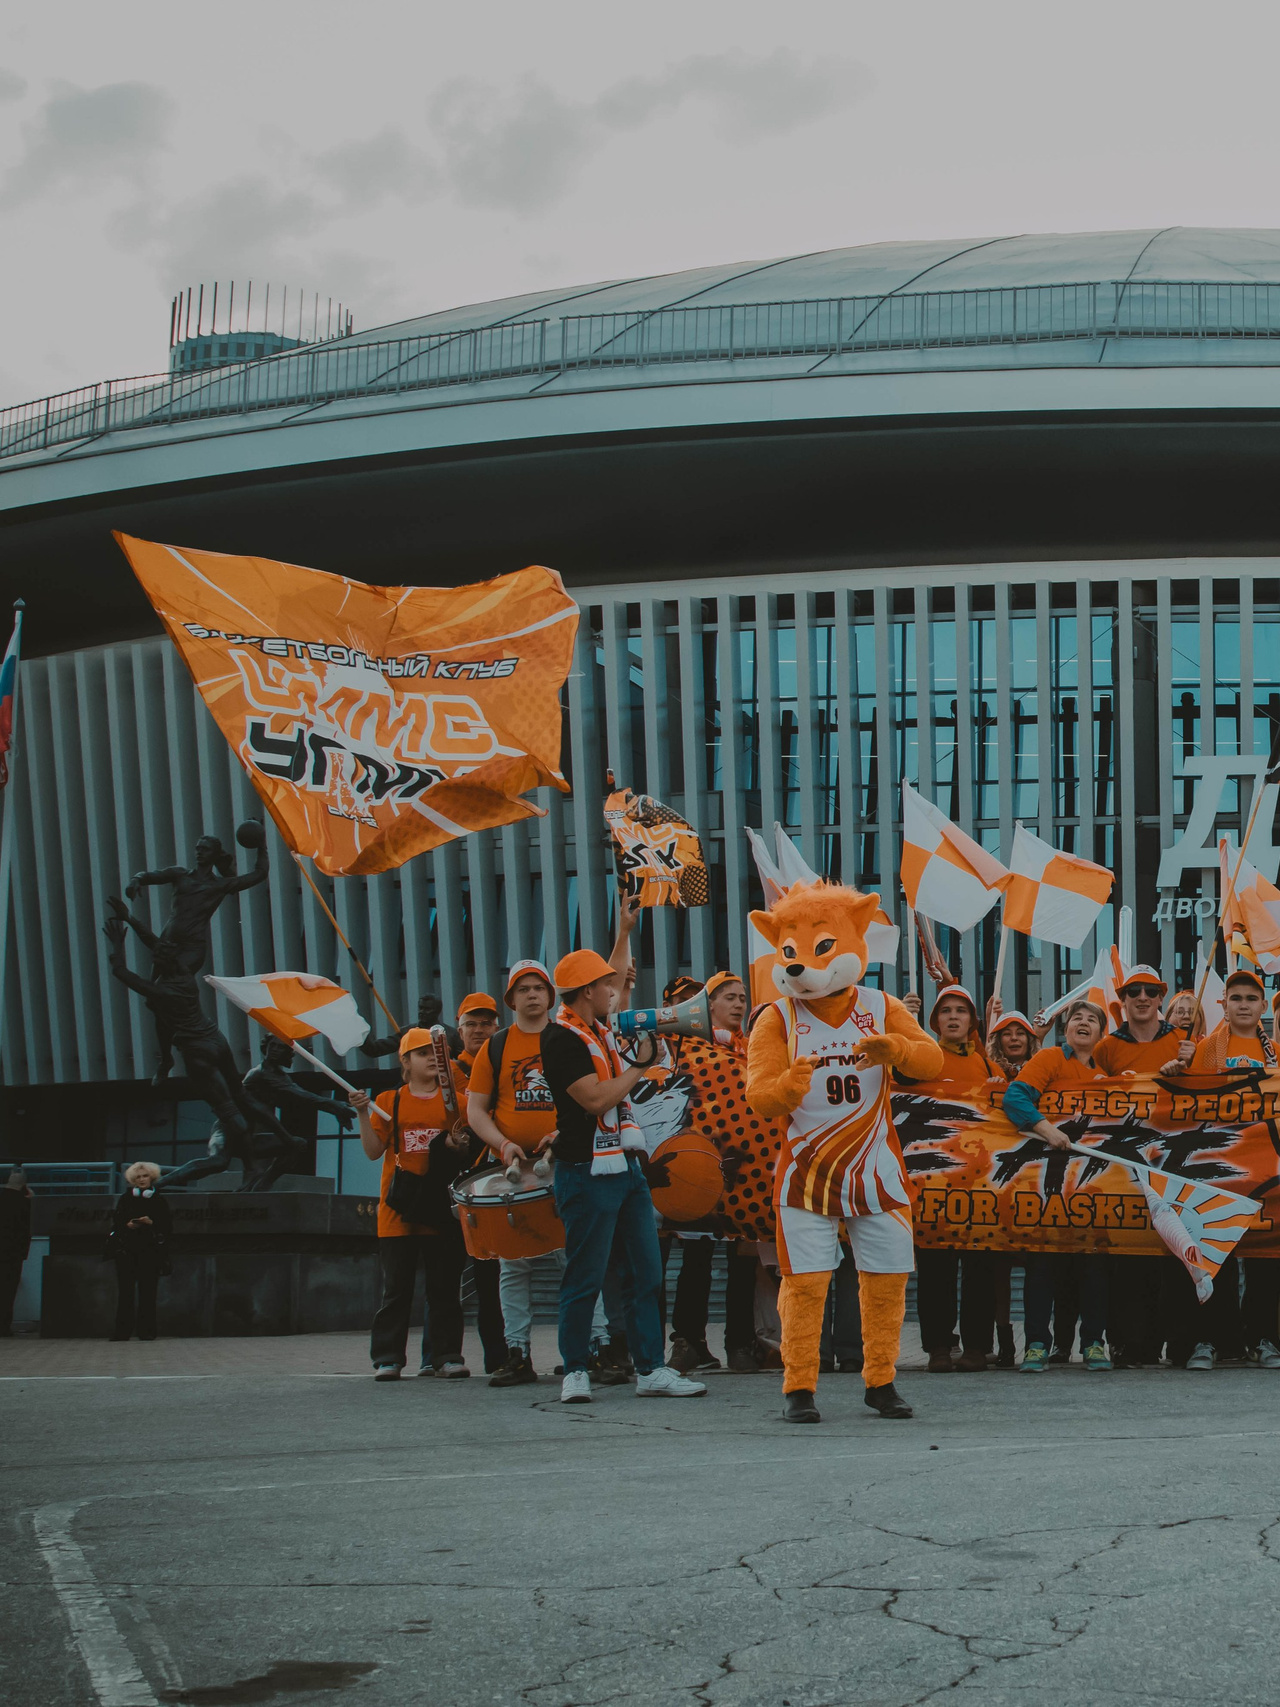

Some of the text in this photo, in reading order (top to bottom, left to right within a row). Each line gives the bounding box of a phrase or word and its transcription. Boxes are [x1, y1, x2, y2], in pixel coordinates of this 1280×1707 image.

[182, 622, 519, 679] БСКЕТБОЛЬНЫЙ КЛУБ
[243, 716, 460, 801] УГМ
[1152, 897, 1222, 922] ДВО
[858, 1014, 872, 1022] FON
[858, 1020, 873, 1028] BET
[515, 1090, 554, 1102] FOX'S
[826, 1074, 861, 1105] 96
[990, 1090, 1157, 1120] RFECT
[921, 1188, 1273, 1231] FOR BASKEL
